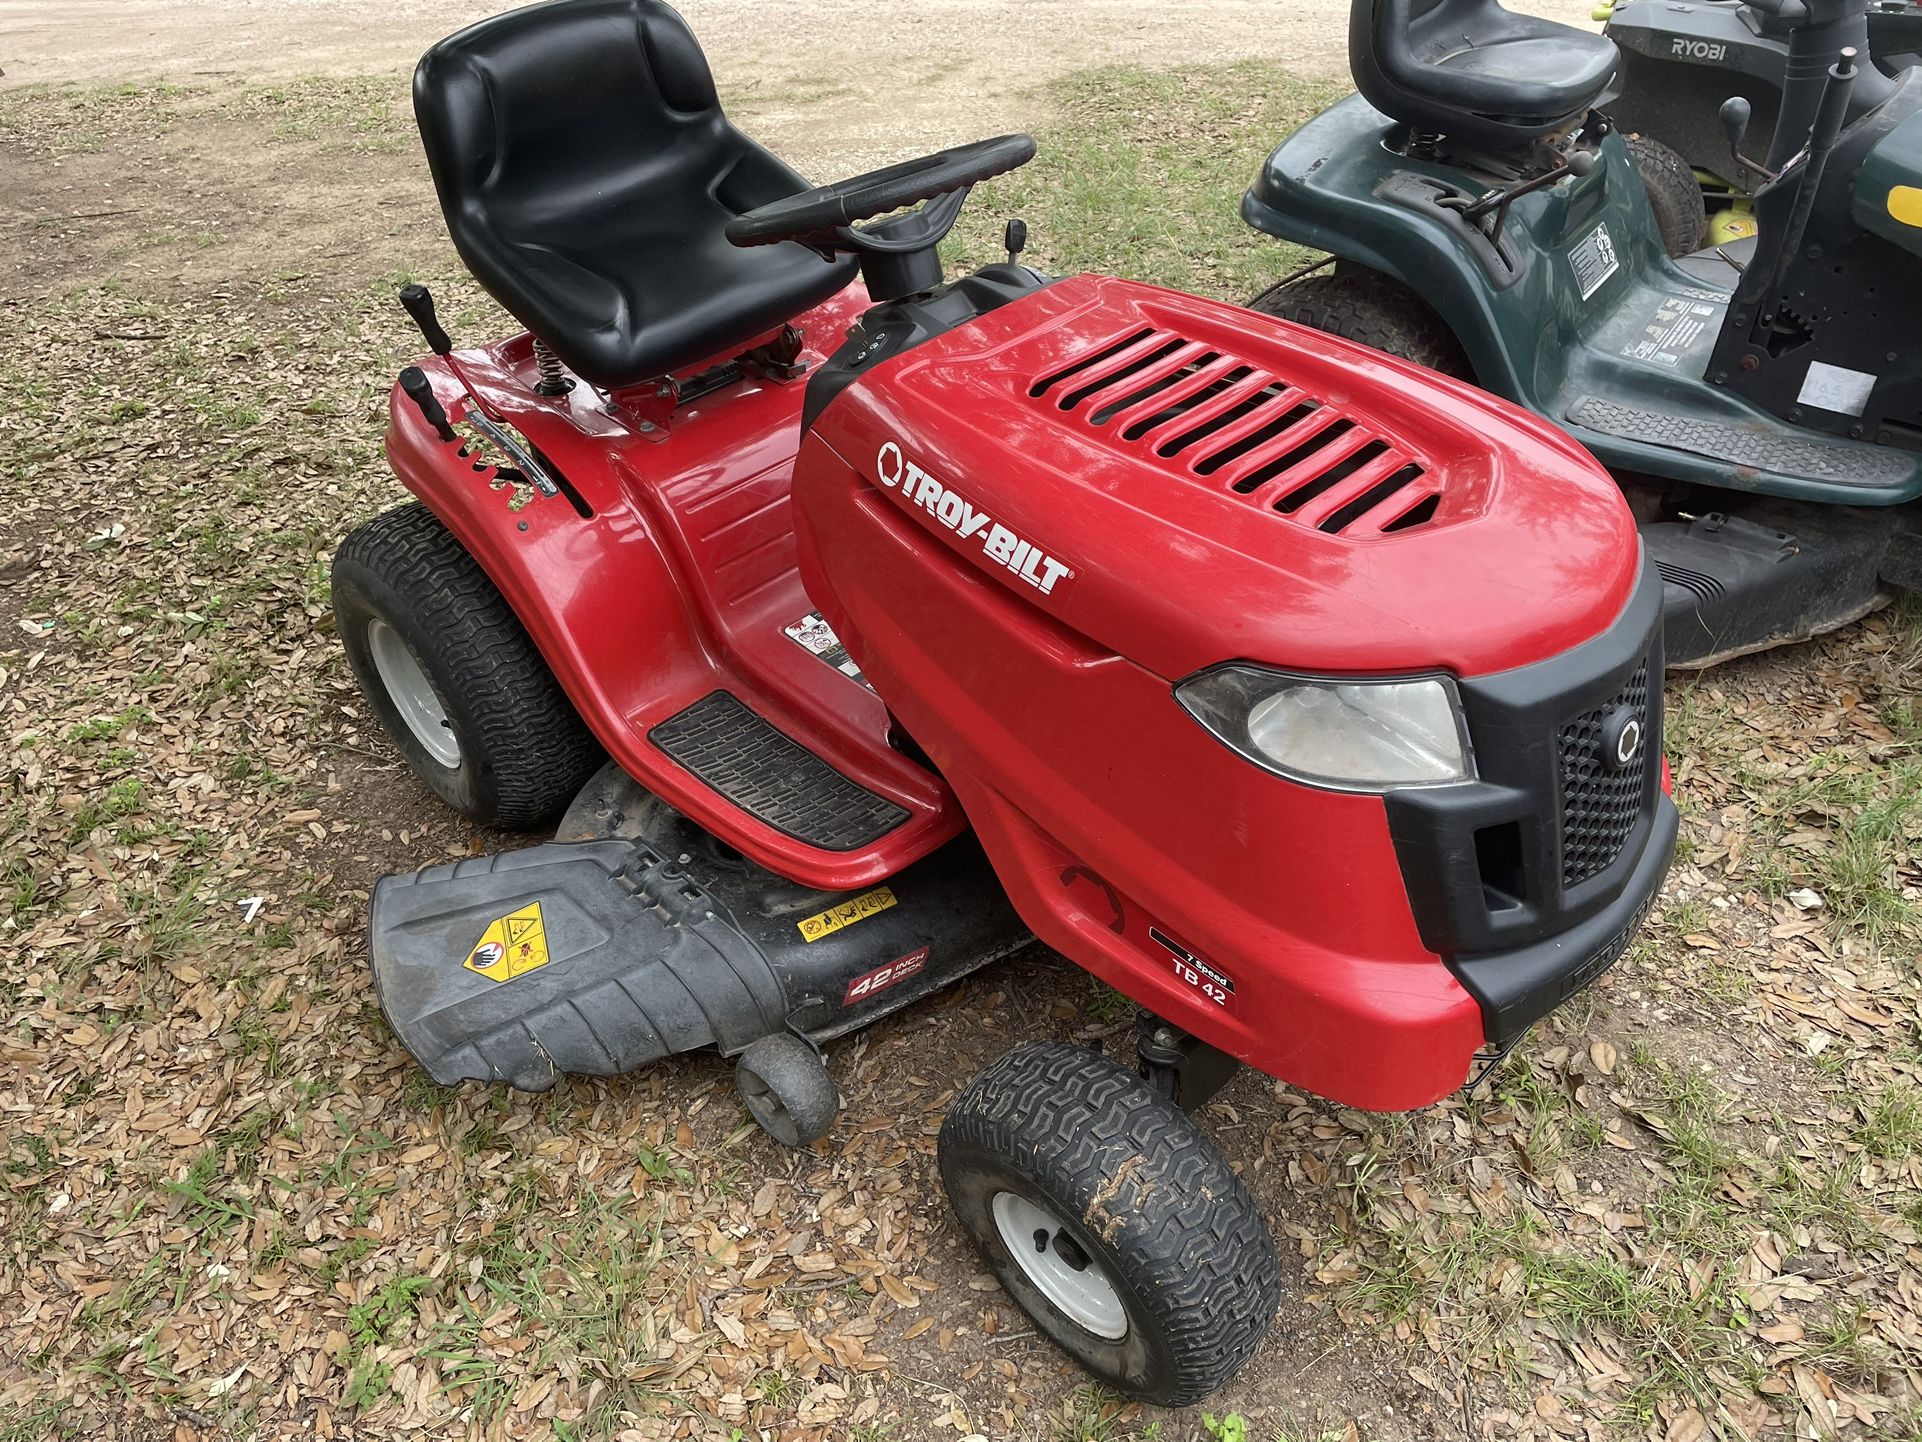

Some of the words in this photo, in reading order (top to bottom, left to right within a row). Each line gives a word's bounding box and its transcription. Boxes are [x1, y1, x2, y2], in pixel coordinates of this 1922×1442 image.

[1671, 38, 1727, 61] RYOBI
[901, 460, 1070, 596] TROY-BILT
[850, 968, 892, 997] 42
[895, 953, 925, 971] INCH
[892, 961, 924, 980] DECK
[1172, 958, 1199, 986] TB
[1202, 983, 1226, 1006] 42
[1187, 953, 1194, 962] 7
[1195, 960, 1227, 987] Speed
